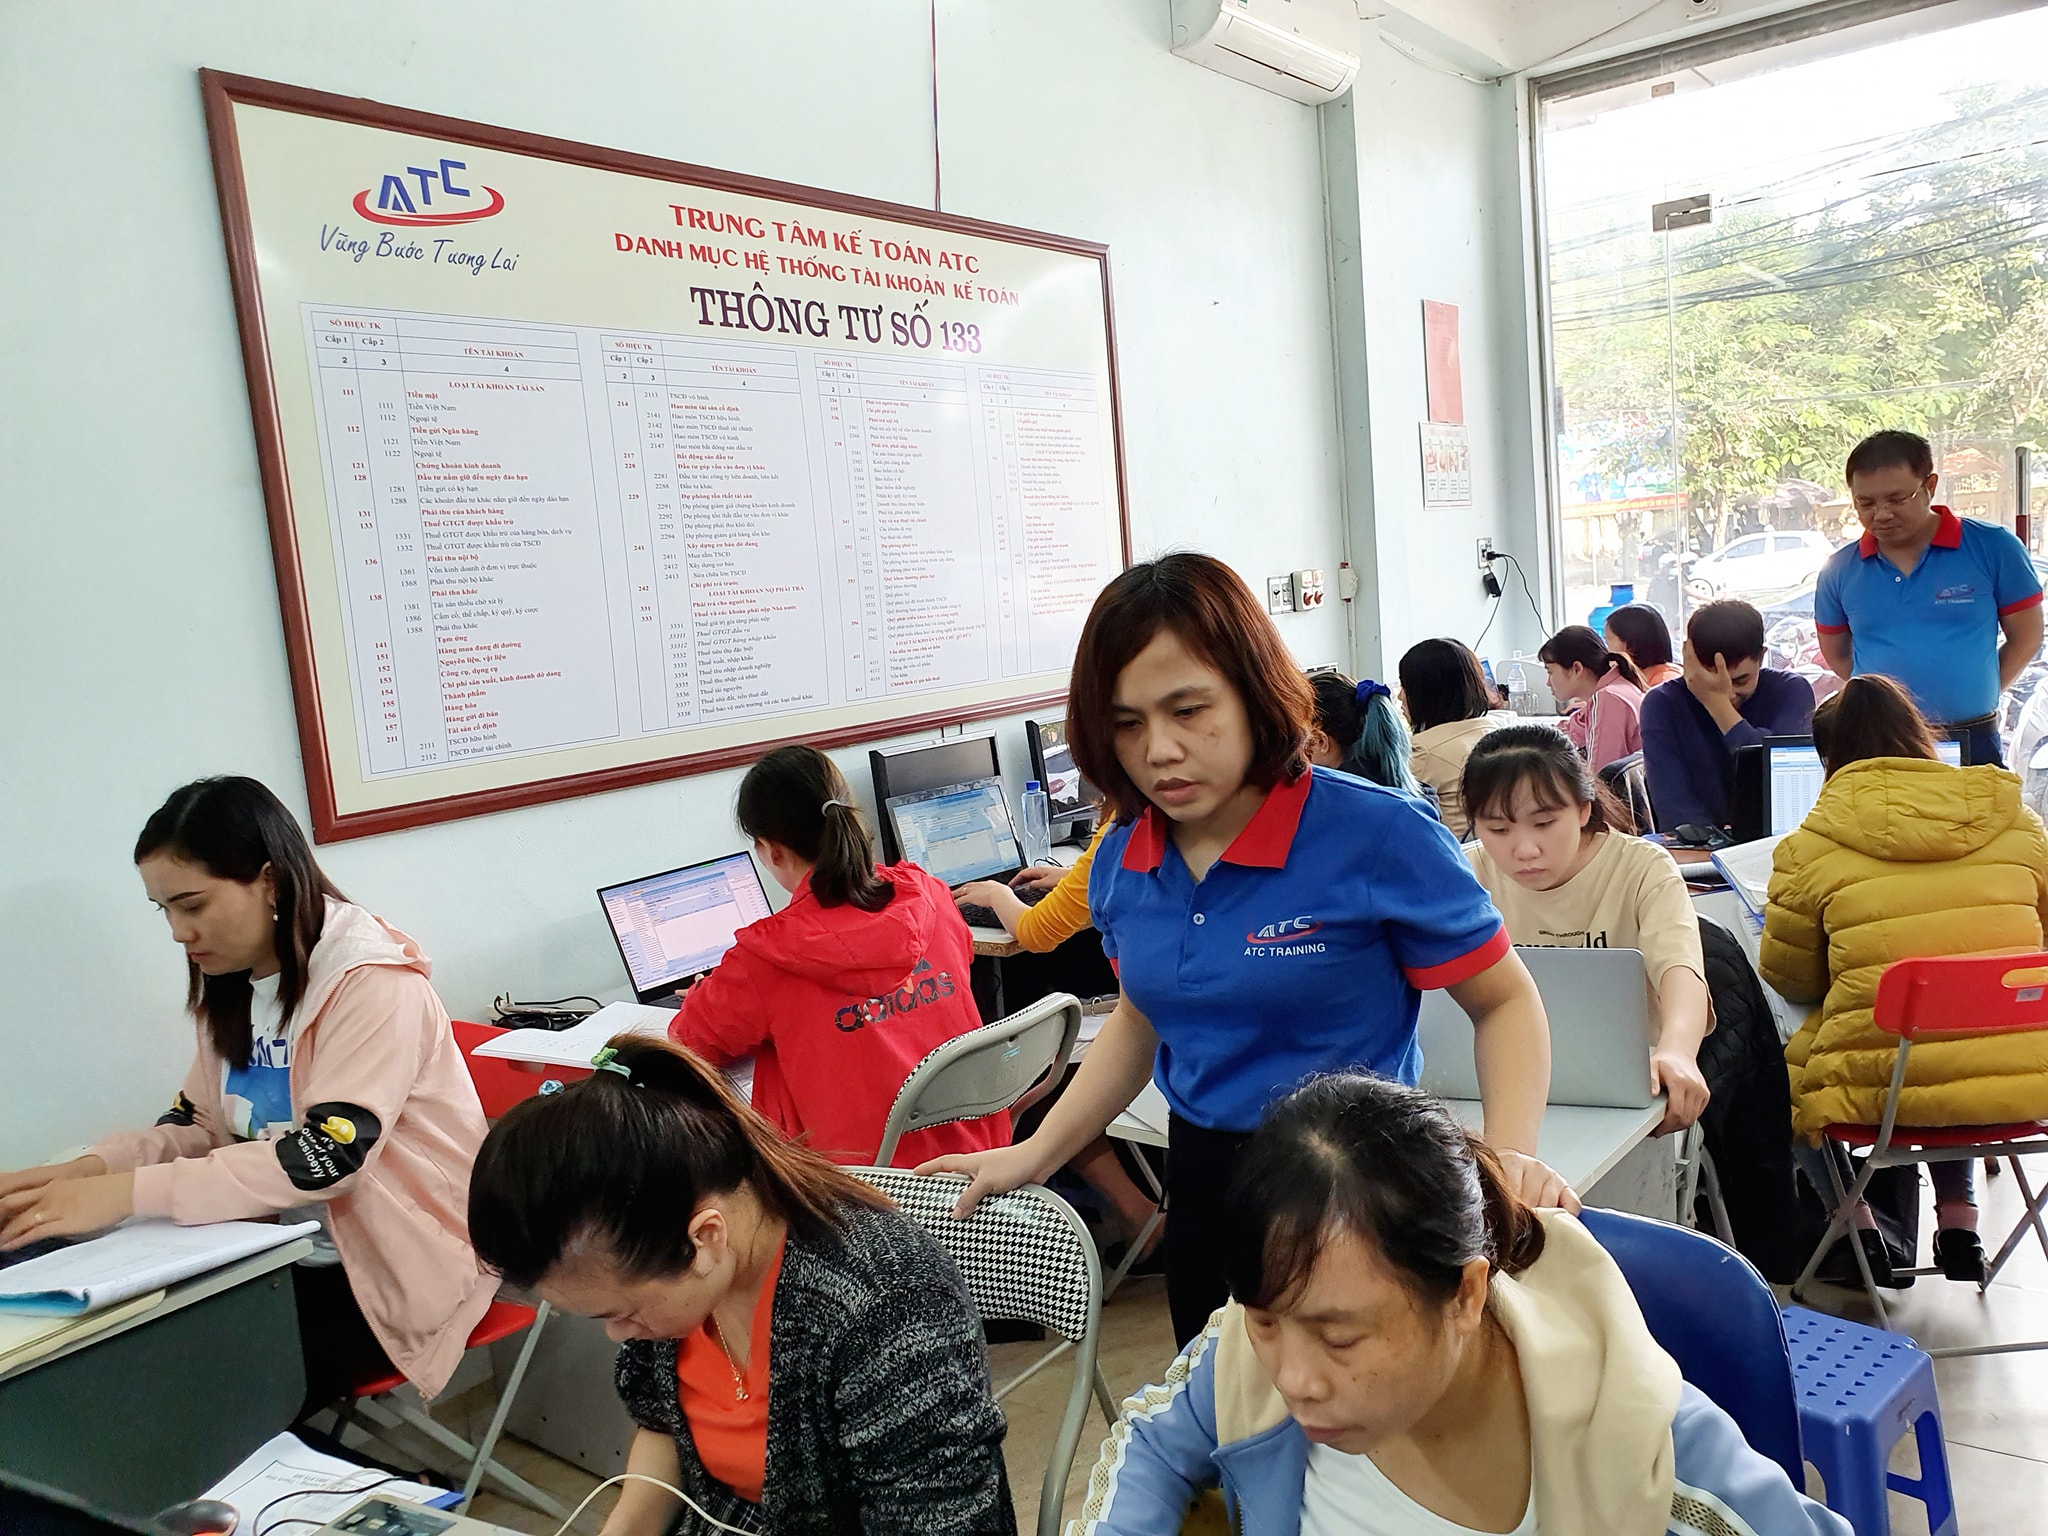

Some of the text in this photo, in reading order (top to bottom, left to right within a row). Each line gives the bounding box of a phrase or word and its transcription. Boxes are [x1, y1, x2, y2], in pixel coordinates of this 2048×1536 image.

[378, 158, 470, 214] ATC
[320, 224, 370, 263] Vững
[376, 232, 424, 261] Bước
[490, 248, 520, 272] Lai
[668, 204, 980, 274] TRUNG TÂM KẾ TOÁN ATC
[614, 233, 1020, 307] DANH MỤC HỆ THỐNG TÀI KHOẢN KẾ TOÁN
[689, 281, 982, 354] THÔNG TƯ SỐ 133
[405, 614, 422, 622] 1386
[419, 742, 434, 750] 2111
[421, 752, 436, 761] 2112
[1258, 916, 1312, 938] ATC
[1244, 943, 1326, 957] ATC TRAINING
[318, 1154, 340, 1178] your
